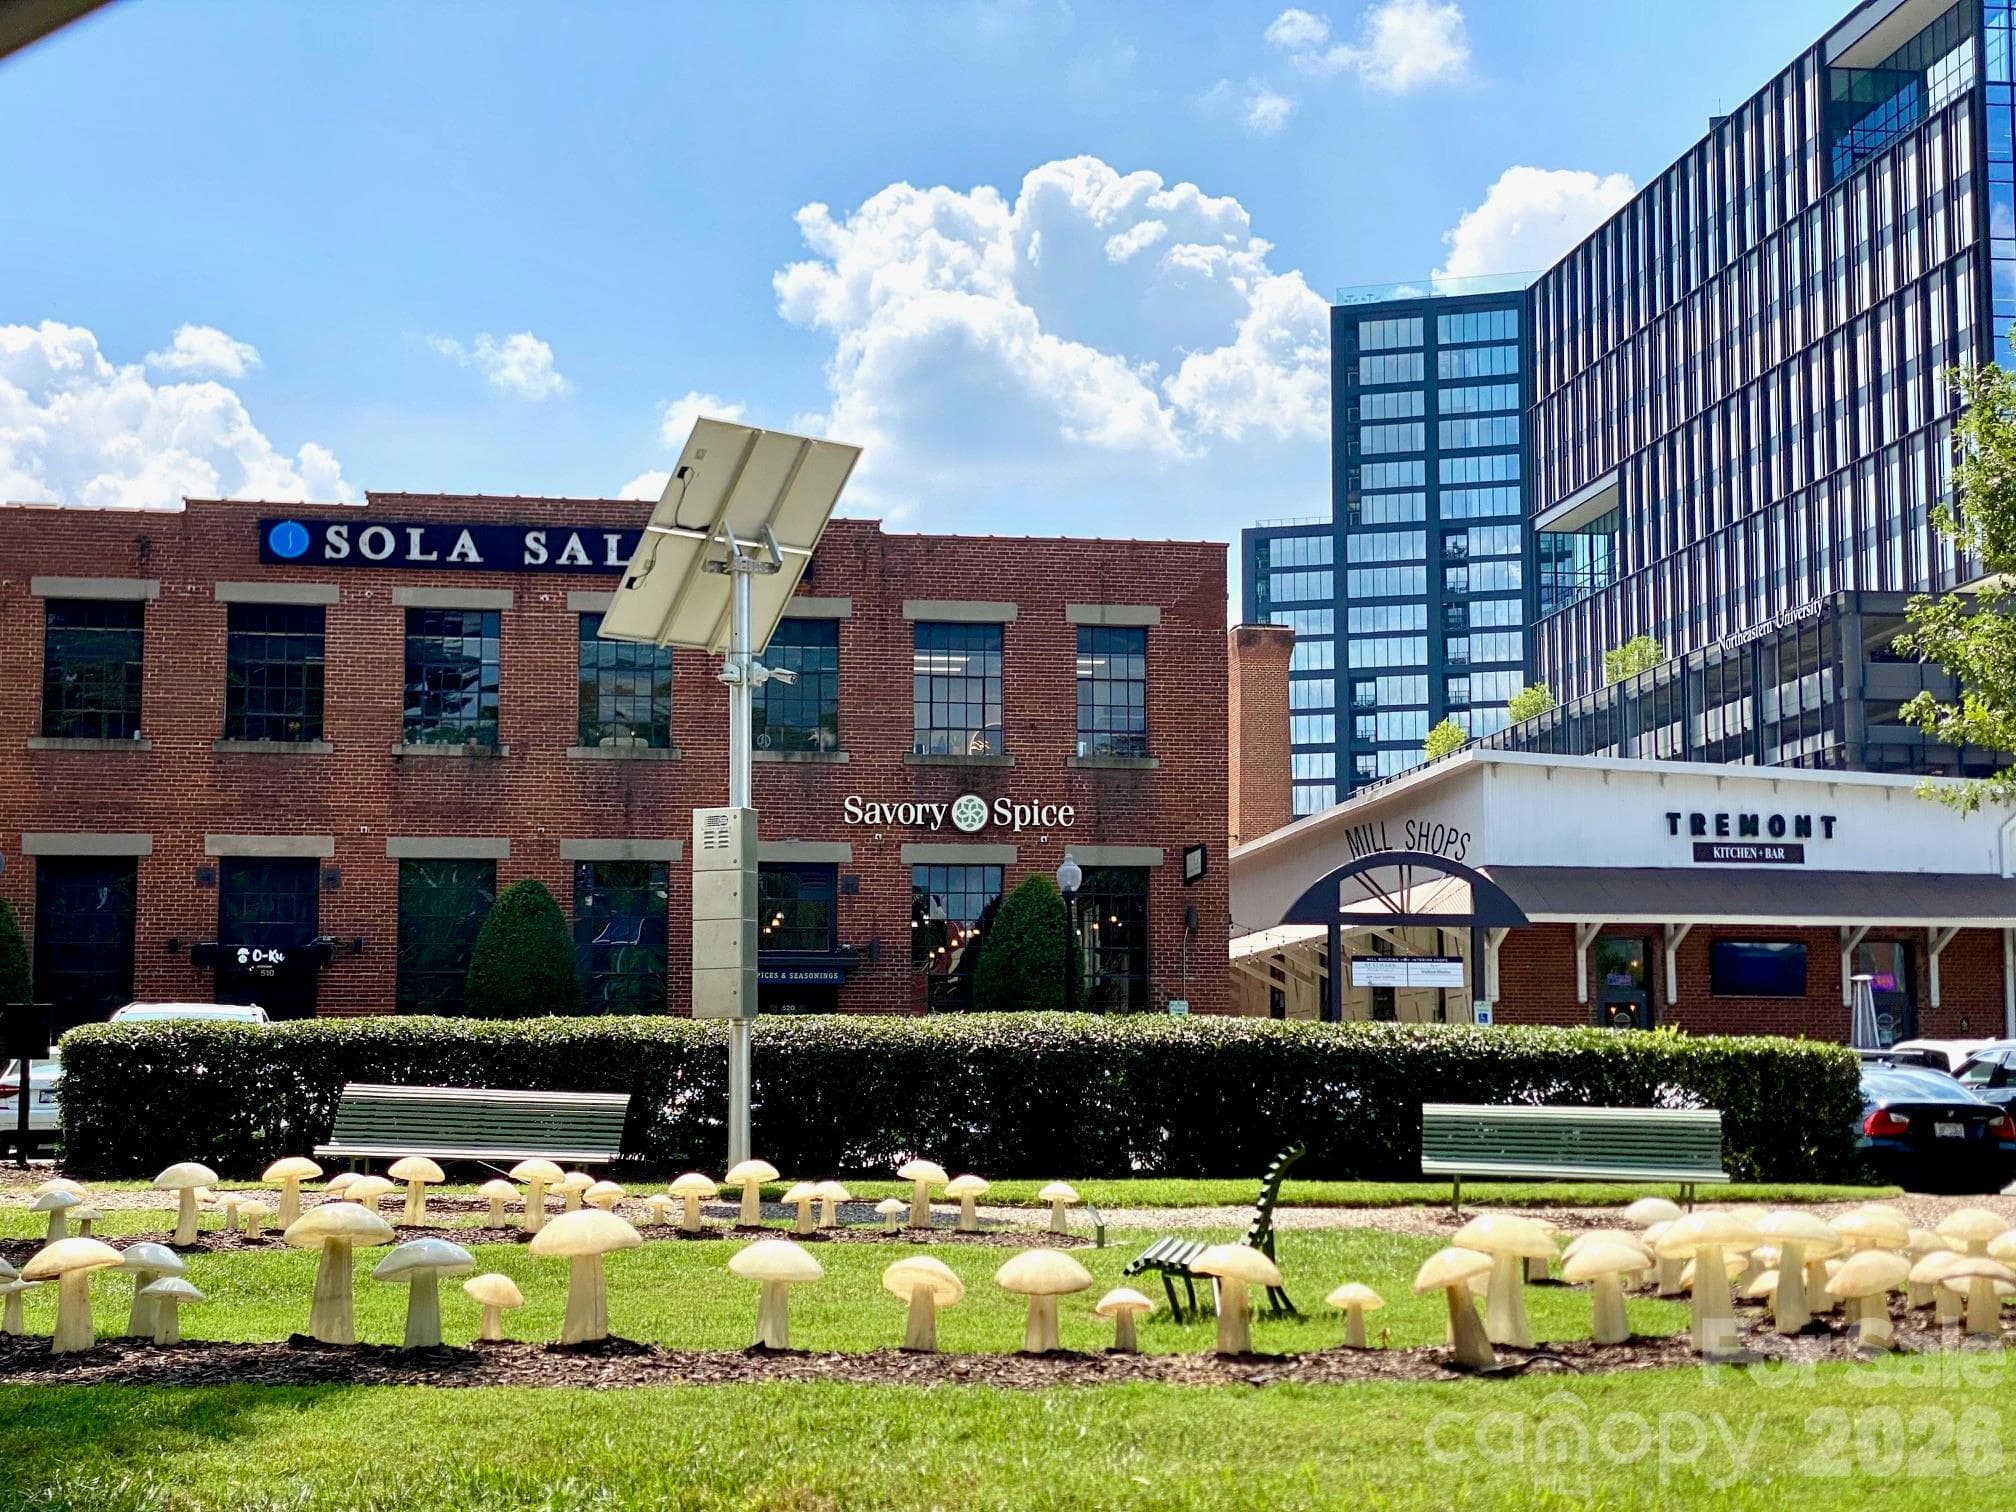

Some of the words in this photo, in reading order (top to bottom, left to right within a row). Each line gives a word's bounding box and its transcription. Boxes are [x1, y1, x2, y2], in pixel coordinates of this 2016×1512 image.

[324, 525, 484, 563] SOLA
[1719, 623, 1773, 656] Northeastern
[1776, 597, 1823, 629] University
[844, 795, 948, 831] Savory
[993, 797, 1075, 832] Spice
[1666, 812, 1837, 839] TREMONT
[1345, 820, 1393, 860] MILL
[1405, 819, 1470, 861] SHOPS
[1713, 846, 1757, 859] KITCHEN
[1765, 847, 1785, 859] BAR
[252, 949, 285, 963] O-Ku
[789, 972, 839, 980] SEASONINGS
